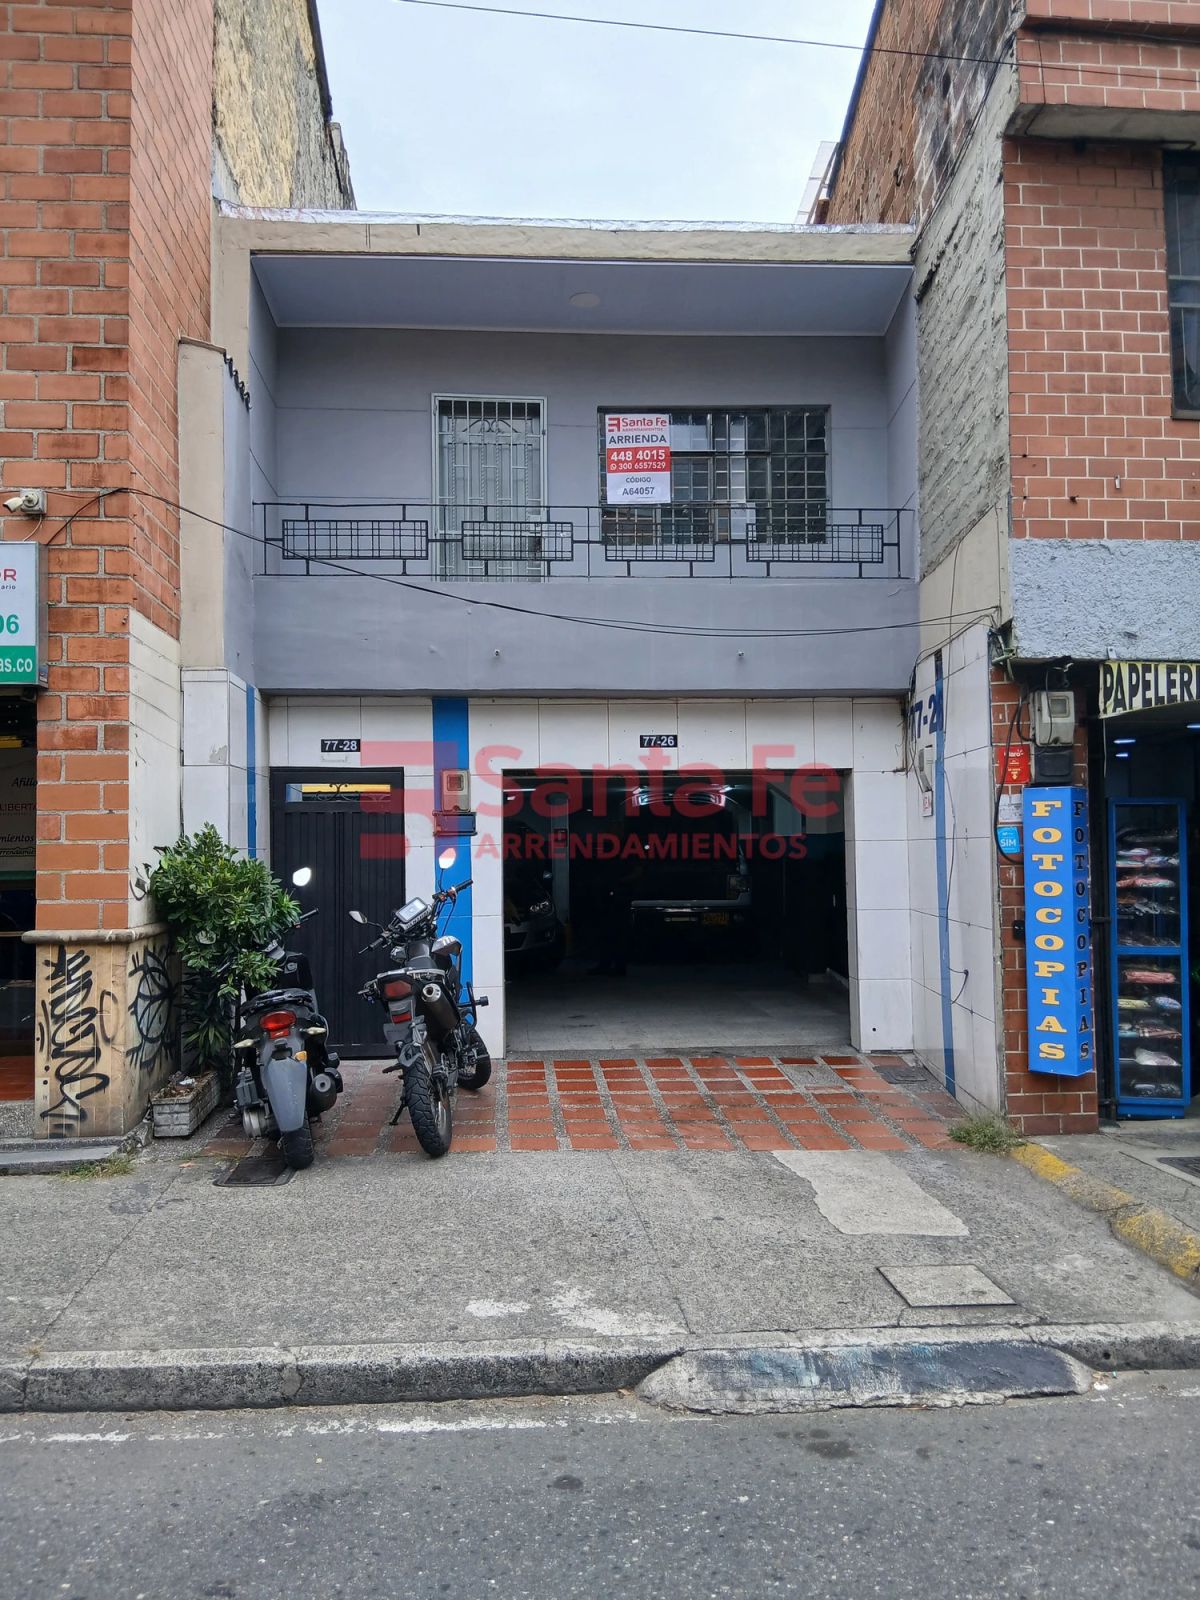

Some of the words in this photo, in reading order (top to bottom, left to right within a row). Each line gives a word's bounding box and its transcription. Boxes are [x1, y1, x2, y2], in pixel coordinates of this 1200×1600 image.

[622, 417, 653, 427] Santa
[656, 417, 667, 427] Fe
[609, 434, 667, 444] ARRIENDA
[610, 451, 633, 461] 448
[636, 449, 666, 460] 4015
[622, 487, 655, 496] A64057
[0, 568, 17, 581] R
[323, 740, 358, 751] 77-28
[642, 736, 675, 747] 77-26
[1000, 838, 1016, 847] SIM
[1032, 801, 1067, 1060] FOTOCOPIAS
[1073, 801, 1089, 1060] FOTOCOPIAS
